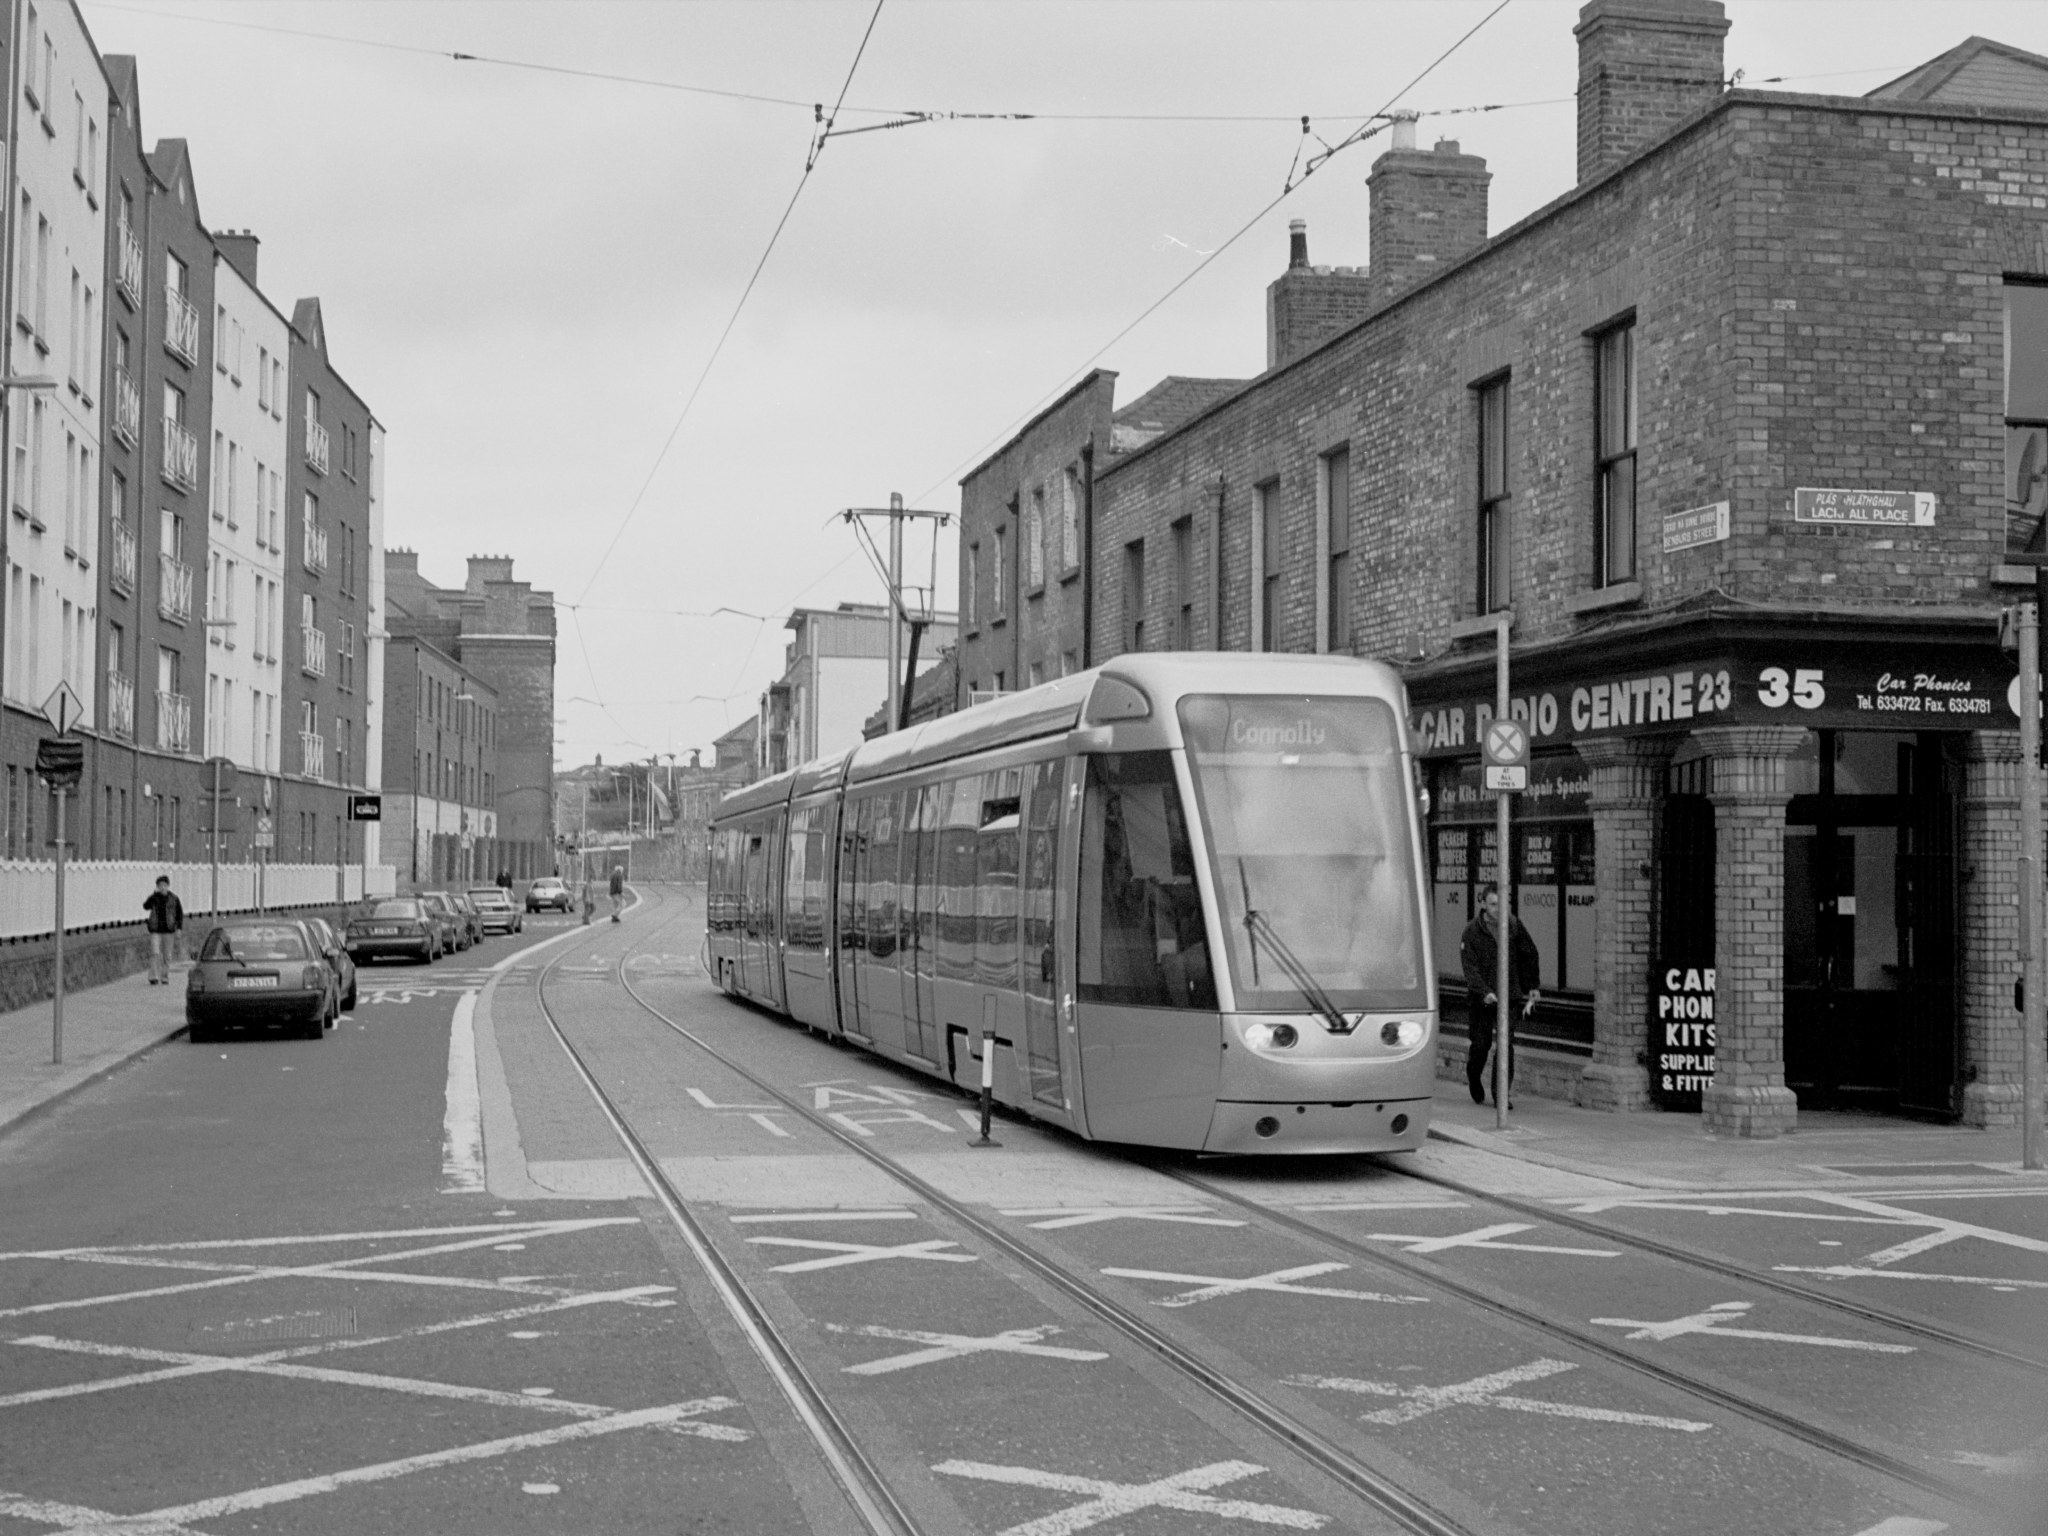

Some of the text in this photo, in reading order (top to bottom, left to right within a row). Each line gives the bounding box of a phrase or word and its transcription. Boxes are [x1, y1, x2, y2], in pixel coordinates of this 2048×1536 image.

[1873, 508, 1909, 521] PLACE
[1919, 501, 1930, 517] 7
[1693, 525, 1716, 541] STREET
[1758, 667, 1826, 709] 35
[1876, 673, 1972, 692] Car Phonics
[1420, 670, 1731, 748] CAR RDIO CENTRE 23
[1857, 695, 1991, 714] Tel. 6334722 Fax. 6334781
[1232, 718, 1326, 745] Connolly
[1527, 851, 1552, 864] COACH
[1447, 892, 1459, 904] JVC
[1523, 893, 1557, 907] KENWOOD
[1666, 968, 1716, 991] CAR
[1666, 1023, 1716, 1047] KITS
[1662, 1074, 1674, 1090] &
